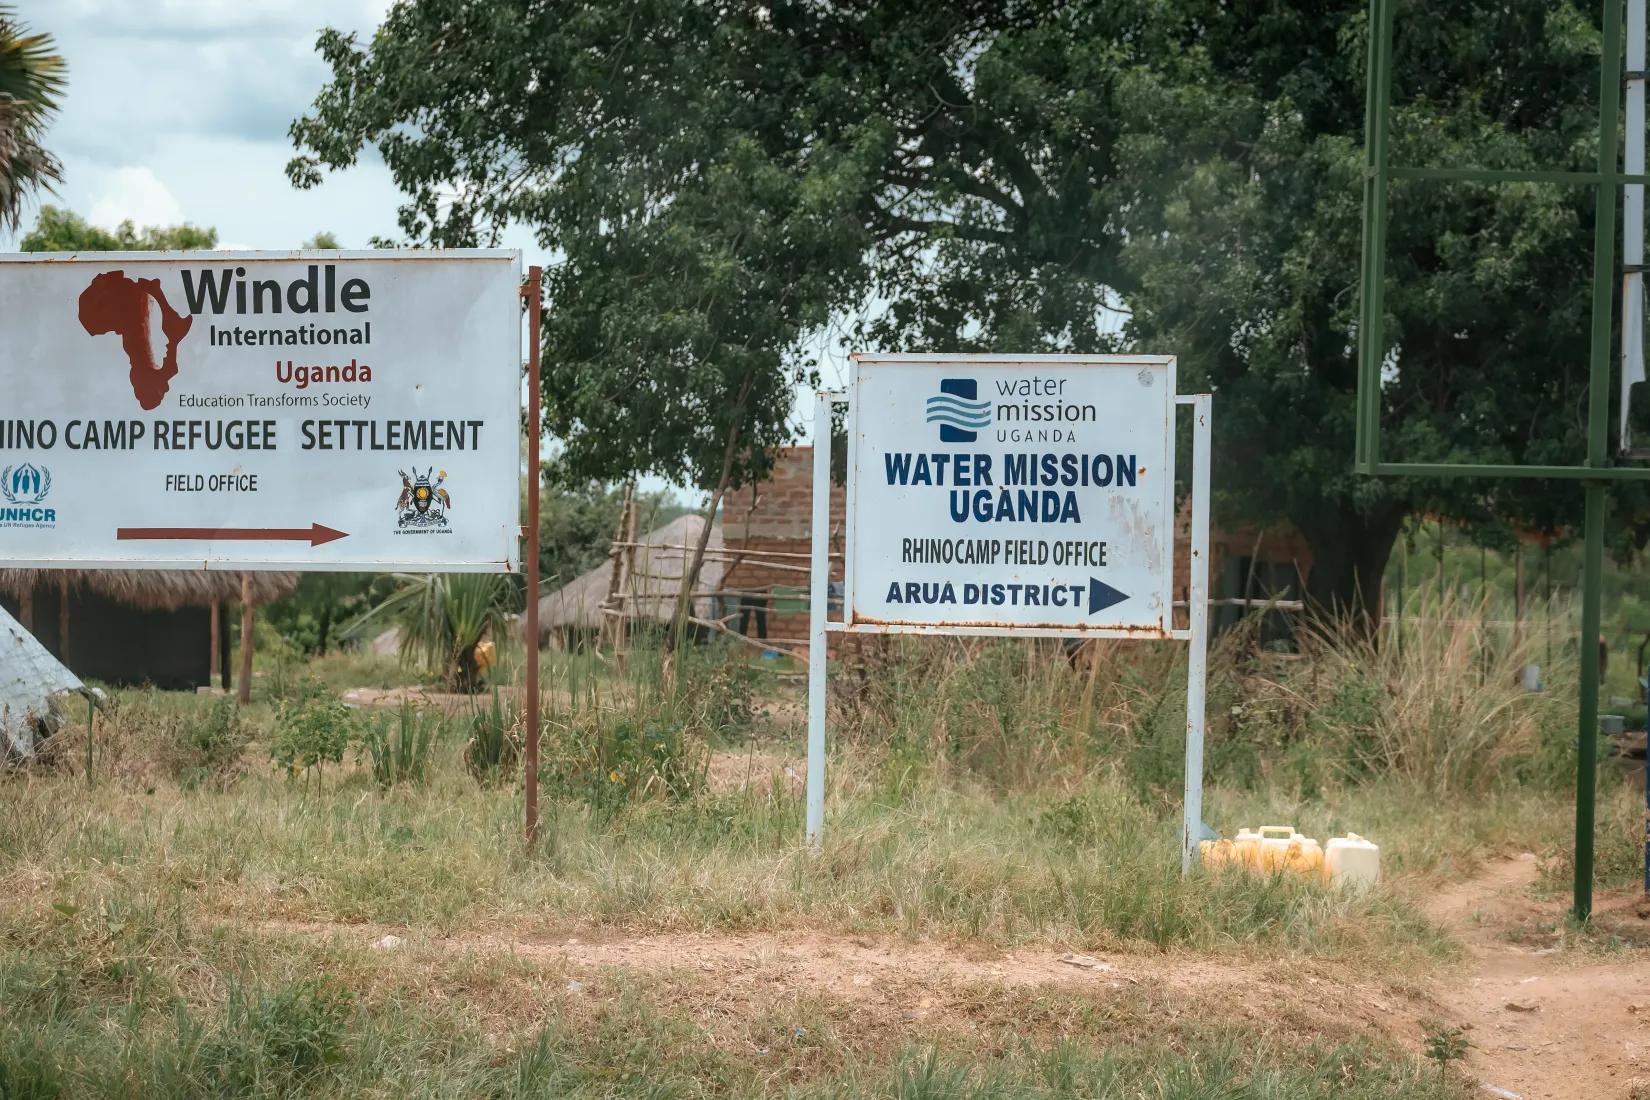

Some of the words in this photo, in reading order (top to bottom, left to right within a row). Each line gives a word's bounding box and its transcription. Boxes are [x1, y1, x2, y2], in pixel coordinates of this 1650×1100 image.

[180, 265, 371, 314] Windle
[210, 322, 371, 346] International
[276, 359, 372, 389] Uganda
[995, 376, 1067, 396] water
[179, 394, 244, 408] Education
[247, 393, 319, 407] Transforms
[322, 392, 372, 409] Society
[997, 399, 1096, 422] mission
[0, 420, 57, 450] INO
[65, 420, 146, 450] CAMP
[153, 420, 277, 450] REFUGEE
[301, 419, 484, 451] SETTLEMENT
[996, 429, 1076, 443] UGANDA
[884, 453, 993, 486] WATER
[1004, 454, 1136, 487] MISSION
[165, 475, 204, 492] FIELD
[208, 474, 258, 492] OFFICE
[950, 489, 1081, 524] UGANDA
[902, 537, 1000, 565] RHINOCAMP
[1004, 540, 1049, 566] FIELD
[1052, 541, 1107, 567] OFFICE
[885, 582, 957, 605] ARUA
[963, 583, 1086, 607] DISTRICT
